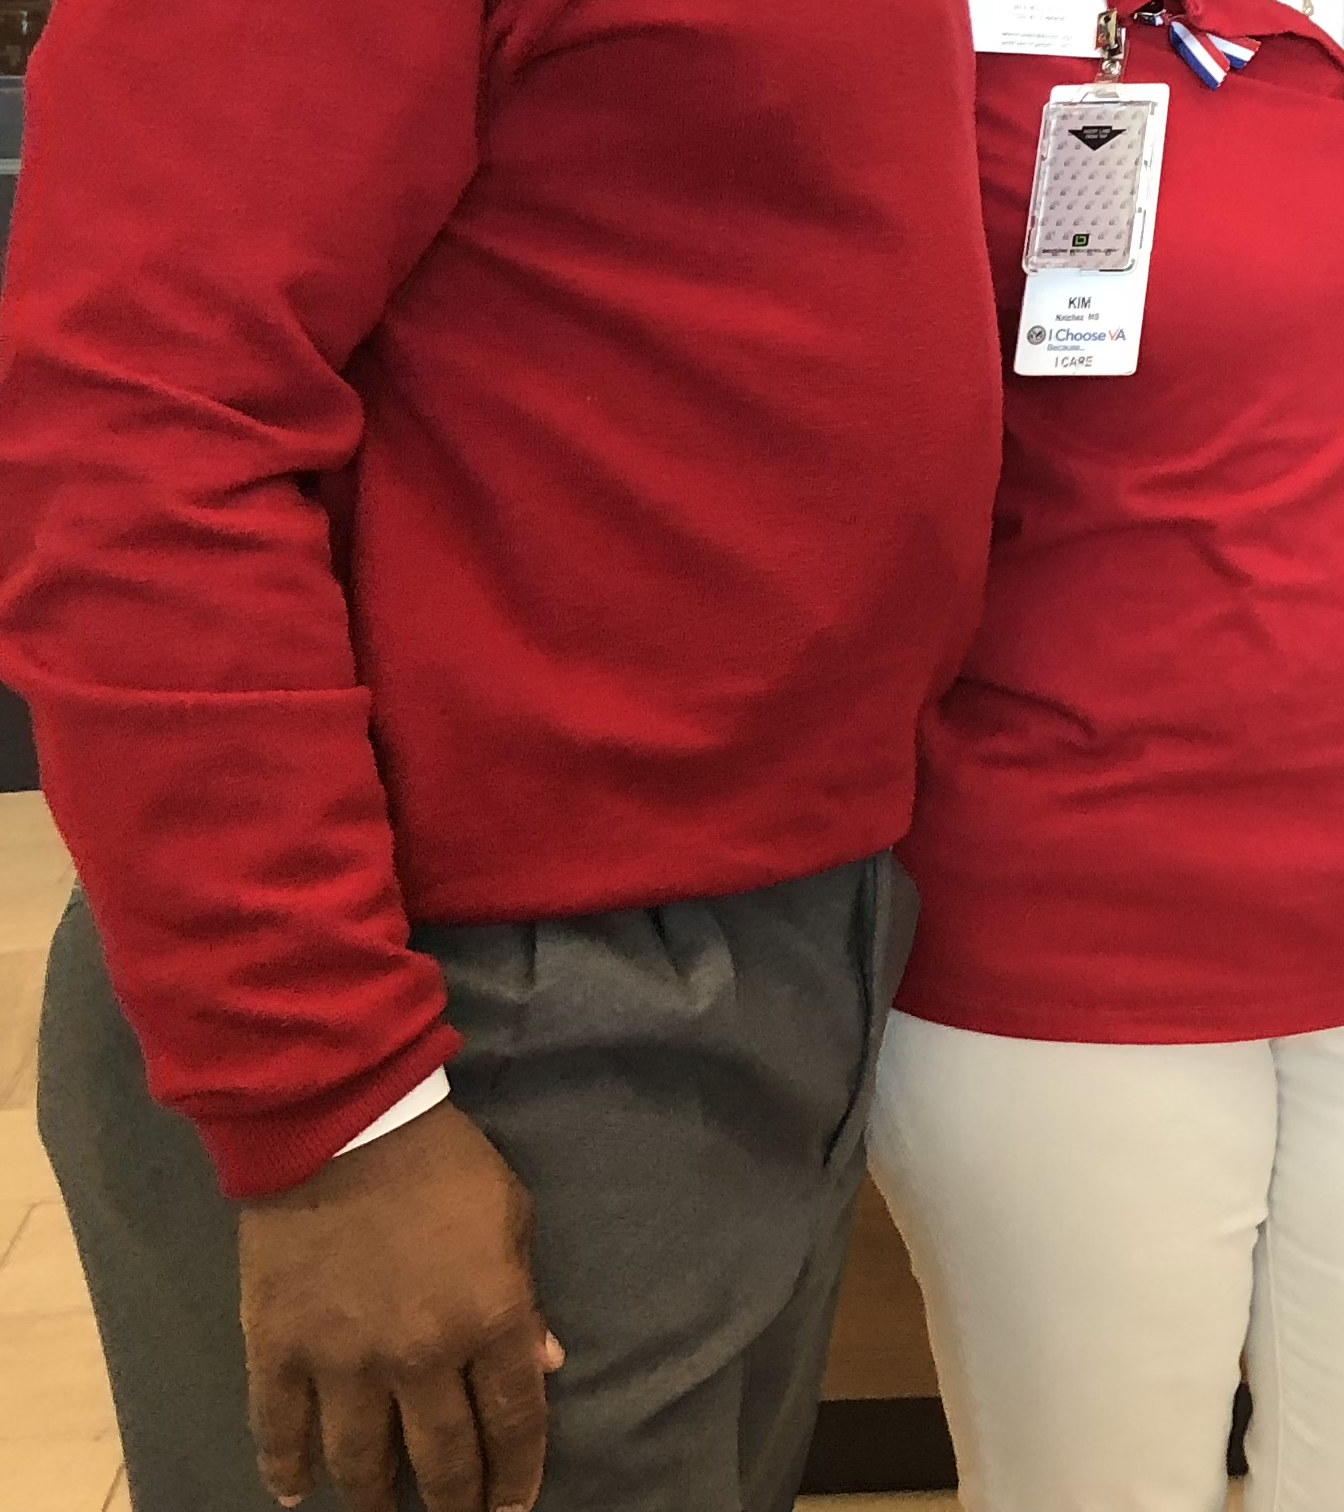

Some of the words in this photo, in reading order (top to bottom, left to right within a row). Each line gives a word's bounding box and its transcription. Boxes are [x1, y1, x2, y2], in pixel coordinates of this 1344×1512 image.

[1067, 296, 1092, 310] KIM
[1055, 328, 1107, 342] Choose
[1108, 326, 1127, 342] VA
[1061, 355, 1094, 368] CARE
